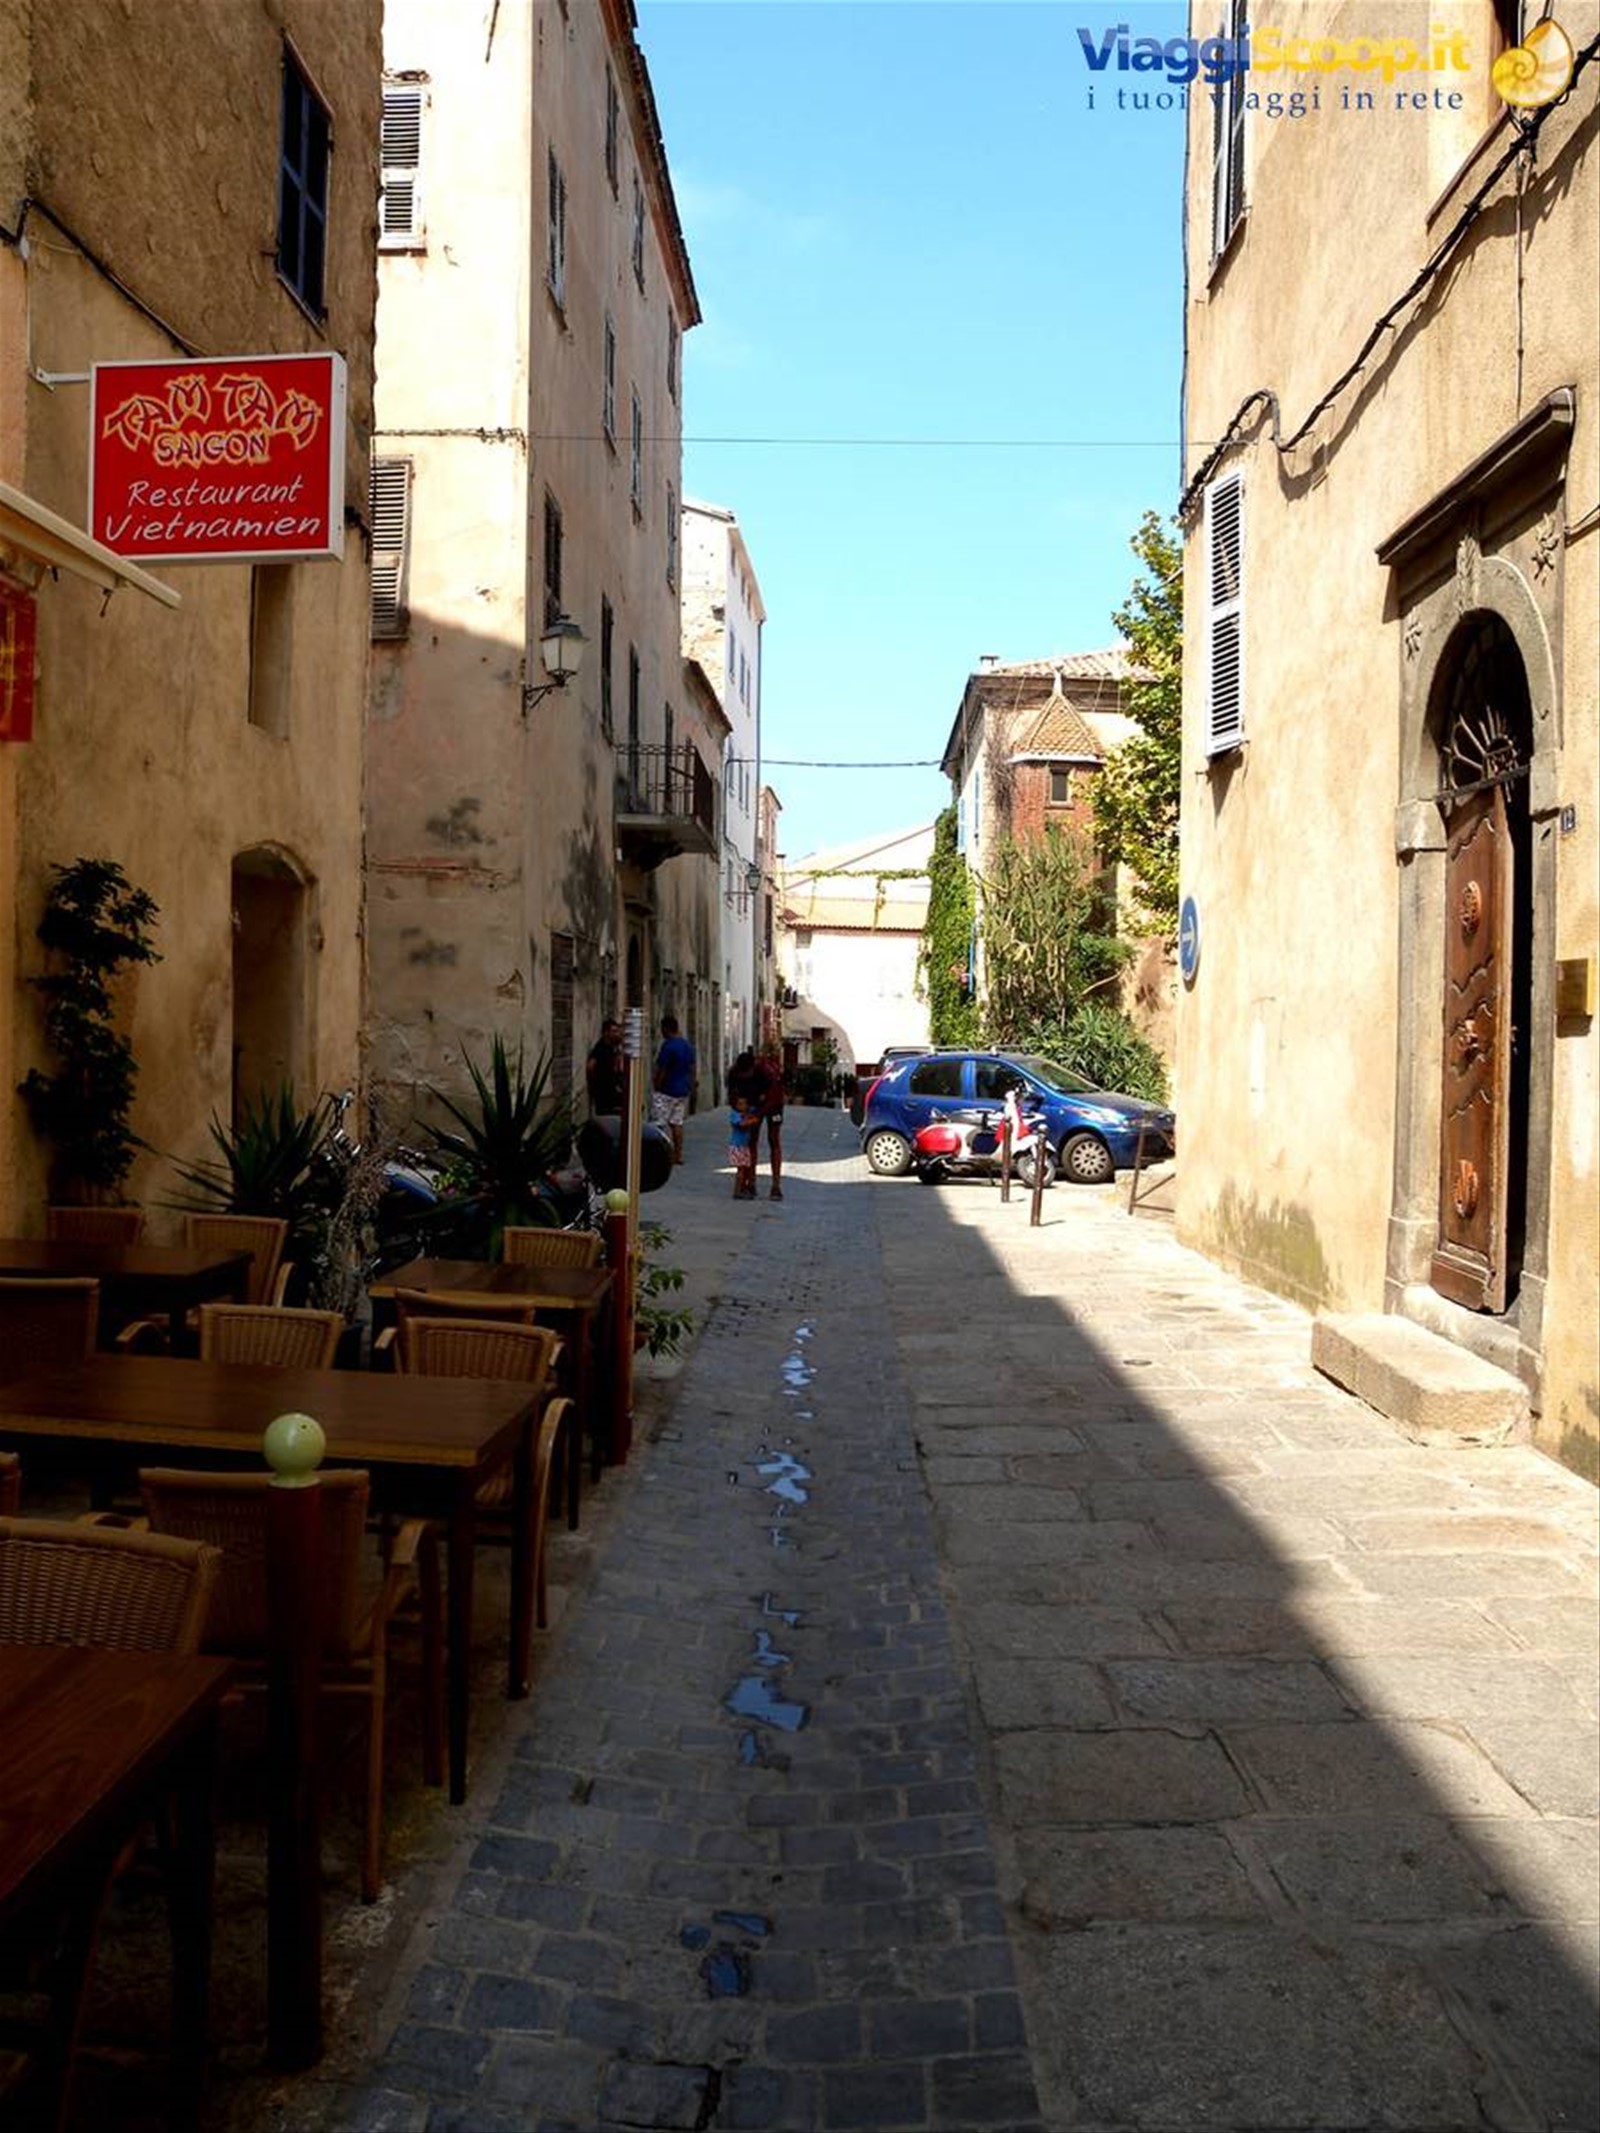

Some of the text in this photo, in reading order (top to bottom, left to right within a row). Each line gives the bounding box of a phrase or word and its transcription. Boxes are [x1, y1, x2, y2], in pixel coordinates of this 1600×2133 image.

[154, 429, 270, 468] SAIGON
[127, 474, 303, 507] Restaurant
[105, 511, 321, 541] Vietnamien
